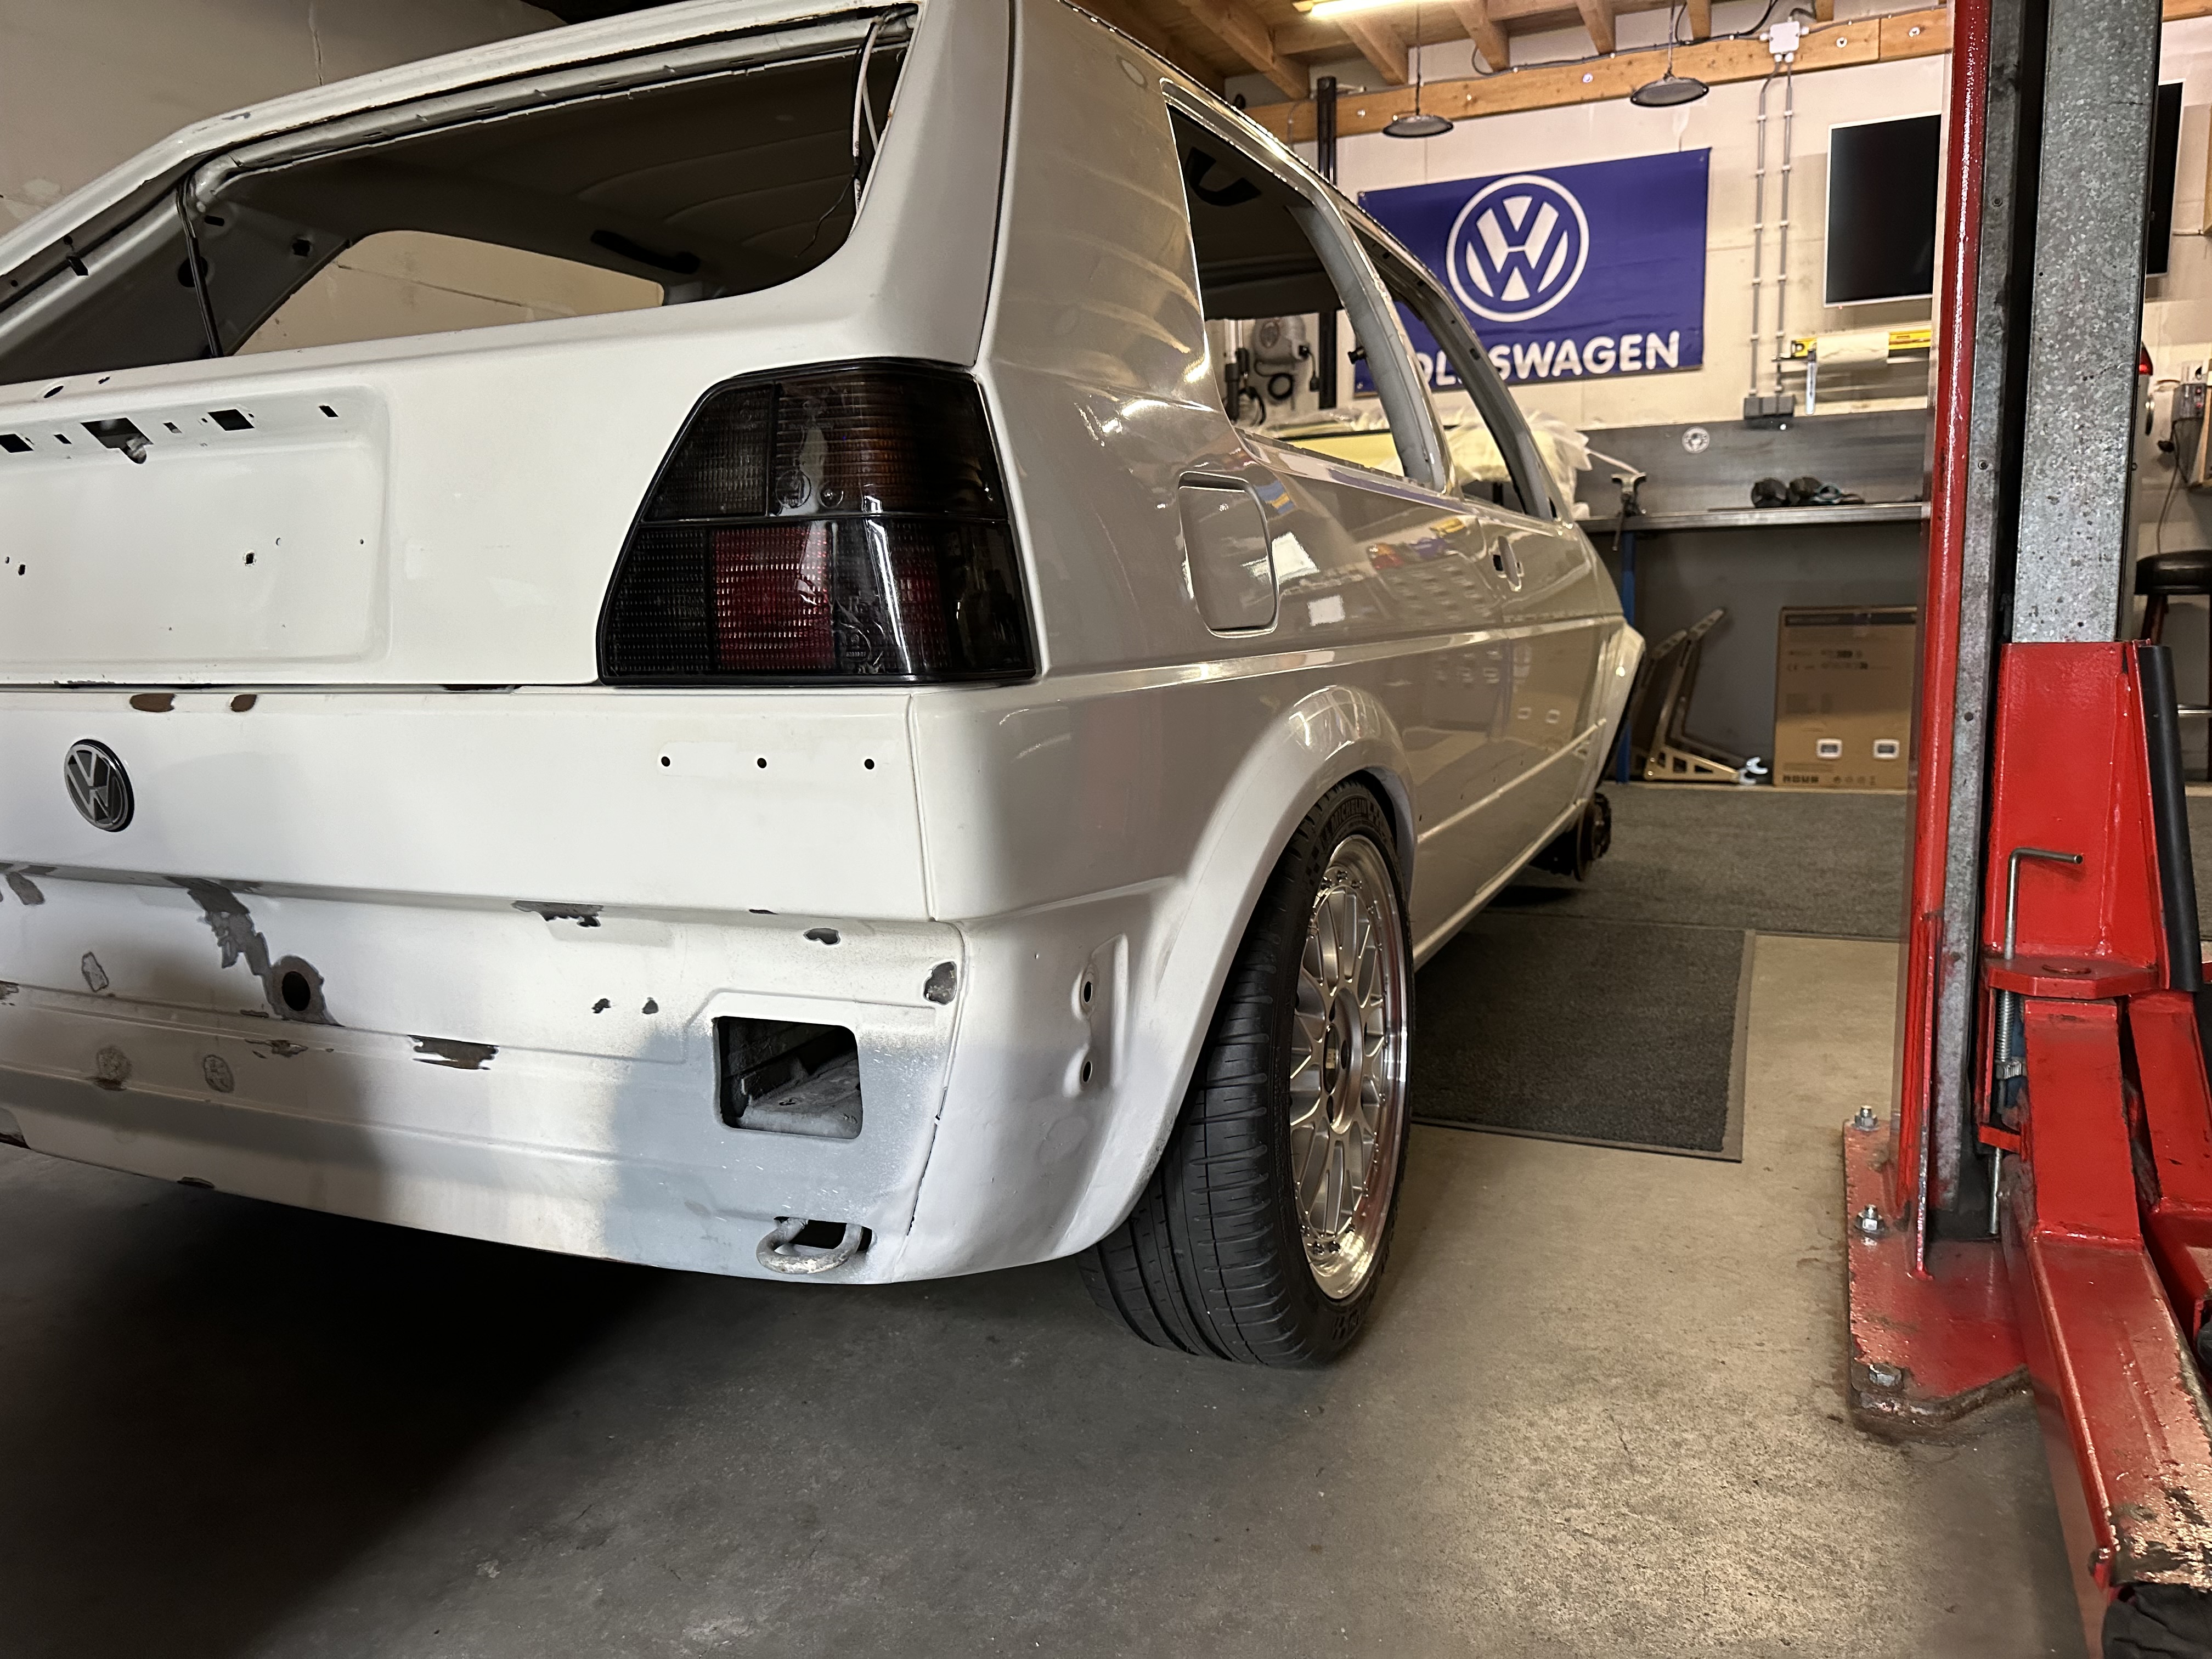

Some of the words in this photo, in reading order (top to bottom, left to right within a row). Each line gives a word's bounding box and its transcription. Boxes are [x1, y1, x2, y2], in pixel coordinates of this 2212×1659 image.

[1452, 181, 1583, 316] VW
[1417, 331, 1680, 386] LSWAGEN
[1330, 798, 1367, 833] MICHELIN
